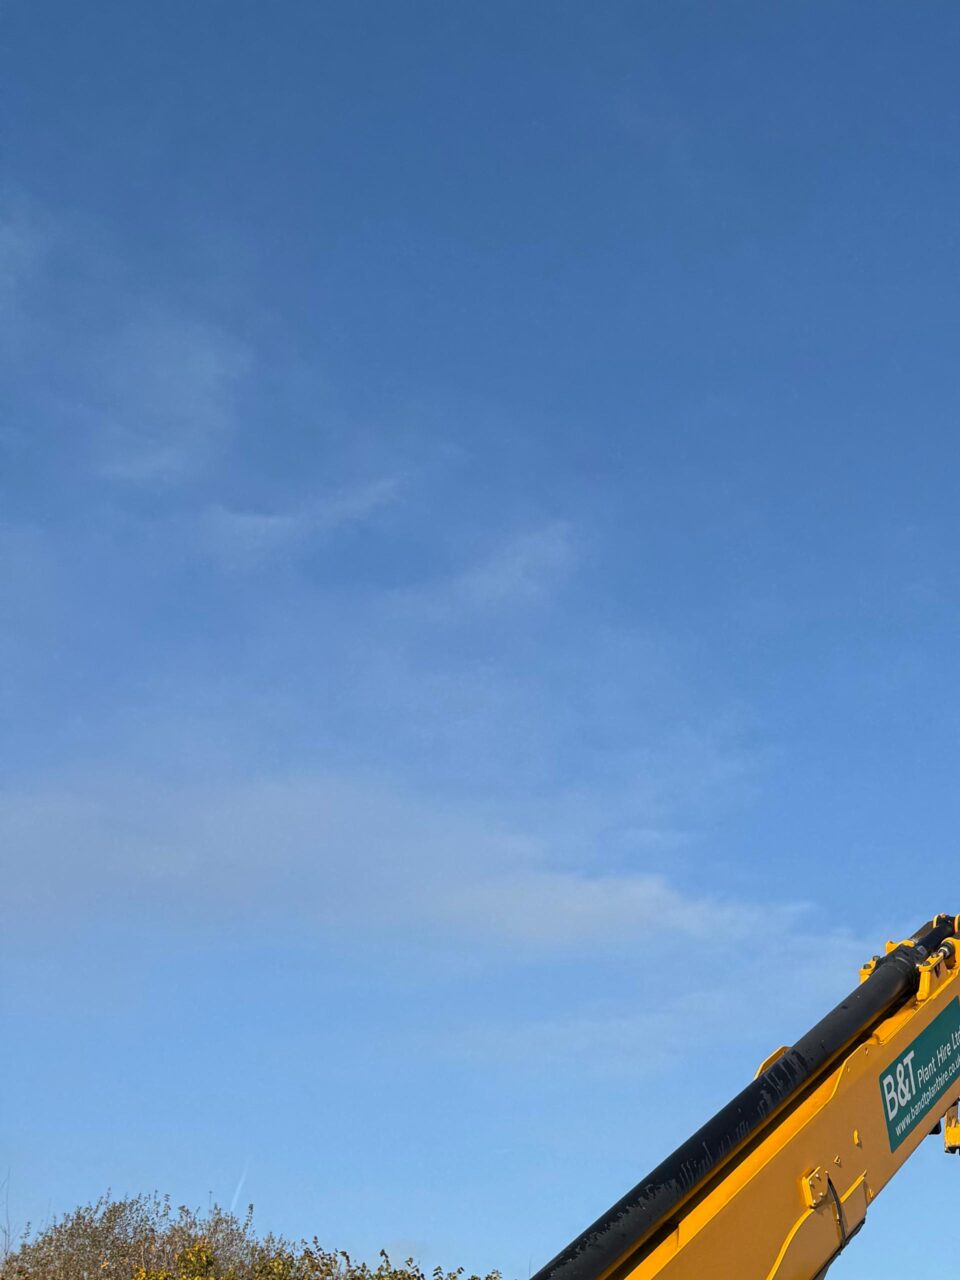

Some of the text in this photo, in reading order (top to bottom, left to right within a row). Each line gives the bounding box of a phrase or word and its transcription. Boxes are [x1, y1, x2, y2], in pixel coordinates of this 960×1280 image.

[883, 1050, 916, 1120] B&T
[917, 1057, 937, 1088] Plant
[936, 1042, 951, 1067] Hire
